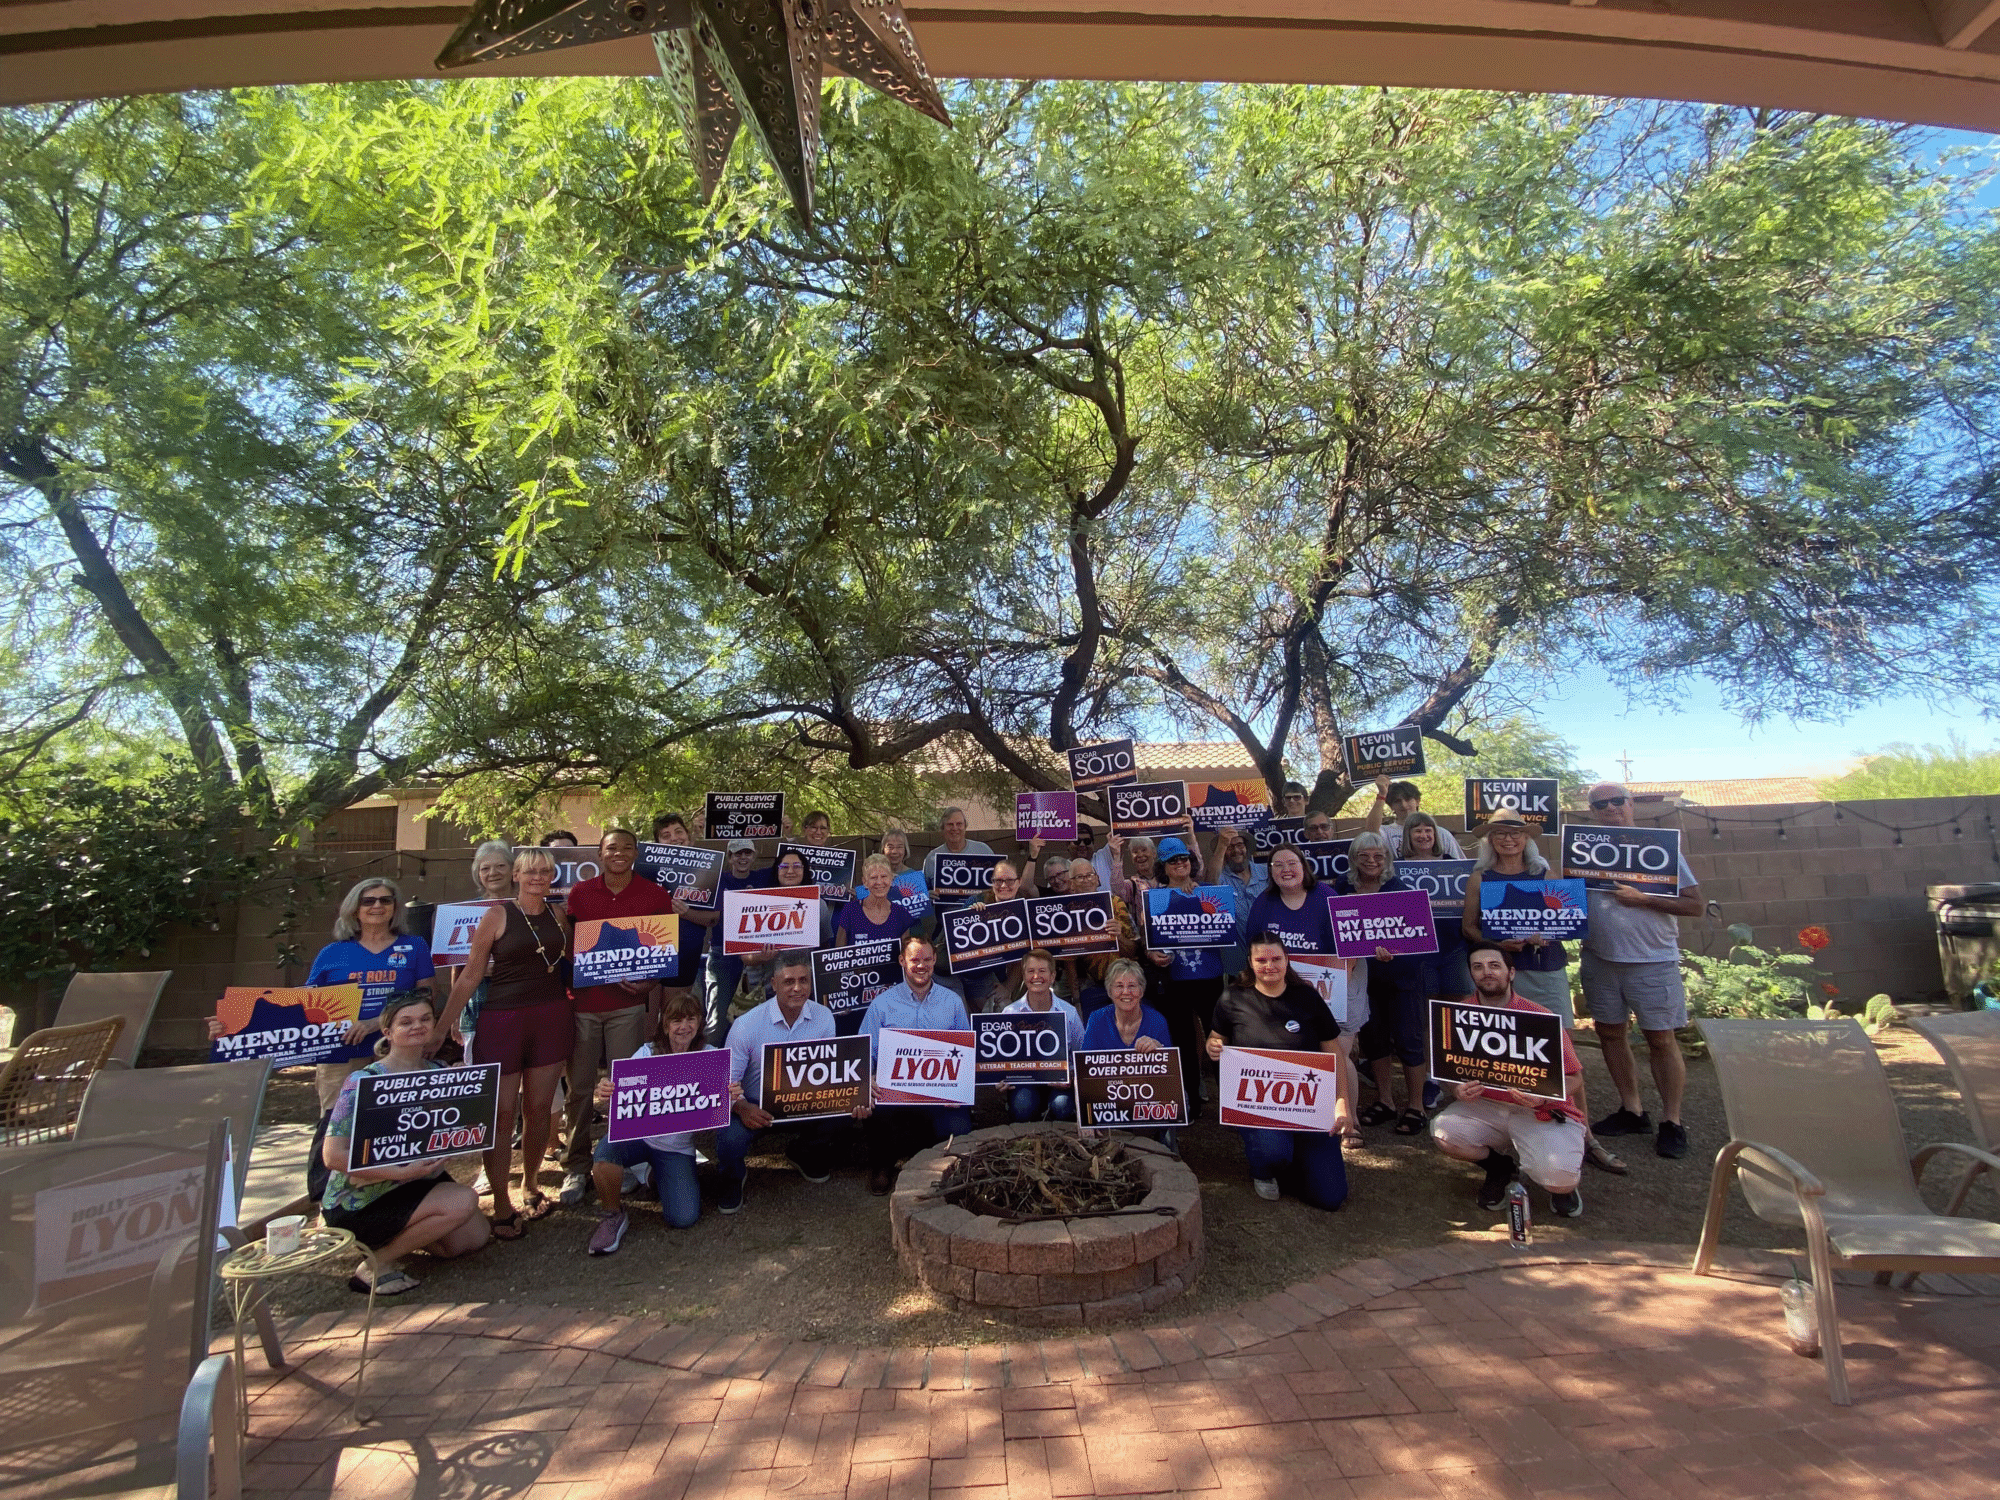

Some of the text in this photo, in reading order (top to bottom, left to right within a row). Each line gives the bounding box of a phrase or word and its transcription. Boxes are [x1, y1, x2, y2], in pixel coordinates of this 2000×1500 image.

[1359, 733, 1396, 746] KEVIN
[1075, 751, 1097, 760] EDGAR
[1361, 741, 1416, 761] VOLK
[1075, 752, 1130, 777] SOTO
[1357, 758, 1416, 771] PUBLIC SERVICE
[1483, 782, 1527, 792] KEVIN
[1117, 791, 1143, 799] EDGAR
[1116, 795, 1181, 819] SOTO
[1192, 804, 1267, 816] MENDOZA
[1483, 794, 1549, 812] VOLK
[728, 814, 762, 824] SOTO
[1018, 810, 1058, 820] MY BODY.
[1018, 818, 1072, 828] MY BALLOT.
[744, 826, 777, 836] LYON
[1574, 833, 1611, 842] EDGAR
[645, 846, 716, 861] PUBLIC SERVICE
[820, 850, 848, 859] SERVICE
[1571, 841, 1670, 870] SOTO
[646, 855, 712, 869] OVER POLITICS
[810, 857, 845, 866] POLITICS
[656, 871, 696, 885] SOTO
[940, 866, 994, 886] SOTO
[1569, 869, 1600, 877] VETERAN
[673, 887, 712, 903] LYON
[742, 905, 769, 913] HOLLY
[1036, 904, 1063, 913] EDGAR
[1481, 908, 1587, 920] MENDOZA
[738, 910, 806, 934] LYON
[953, 915, 980, 927] EDGAR
[1035, 908, 1107, 936] SOTO
[1151, 913, 1235, 925] MENDOZA
[1337, 916, 1406, 931] MY BODY.
[953, 916, 1023, 949] SOTO
[1280, 932, 1305, 942] BODY.
[1339, 926, 1428, 942] MY BALLOT.
[574, 944, 678, 966] MENDOZA
[822, 944, 892, 962] PUBLIC SERVICE
[955, 951, 979, 959] VETERAN
[983, 946, 1005, 954] TEACHER
[610, 957, 672, 968] CONGRESS
[825, 954, 891, 972] OVER POLITICS
[366, 970, 396, 982] BOLD
[840, 971, 880, 990] SOTO
[367, 987, 395, 996] STRONG
[828, 991, 849, 1000] KEVIN
[829, 996, 859, 1010] VOLK
[982, 1022, 1012, 1031] EDGAR
[1455, 1009, 1516, 1031] KEVIN
[217, 1020, 353, 1052] MENDOZA
[979, 1030, 1060, 1058] SOTO
[1456, 1027, 1550, 1063] VOLK
[225, 1048, 256, 1058] FOR
[786, 1044, 837, 1062] KEVIN
[1085, 1053, 1168, 1064] PUBLIC SERVICE
[786, 1059, 862, 1088] VOLK
[891, 1057, 961, 1081] LYON
[1089, 1065, 1167, 1076] OVER POLITICS
[1240, 1068, 1273, 1078] HOLLY
[1446, 1054, 1548, 1078] PUBLIC SERVICE
[373, 1069, 487, 1092] PUBLIC SERVICE
[1456, 1066, 1484, 1078] OVER
[1488, 1071, 1537, 1087] POLITICS
[376, 1083, 482, 1105] OVER POLITICS
[617, 1082, 700, 1104] MY BODY.
[774, 1087, 859, 1103] PUBLIC SERVICE
[1107, 1084, 1154, 1100] SOTO
[1237, 1078, 1318, 1106] LYON
[617, 1094, 721, 1119] MY BALLOT.
[783, 1099, 850, 1113] OVER POLITICS
[1133, 1103, 1178, 1120] LYON
[397, 1107, 460, 1131] SOTO
[1094, 1110, 1130, 1122] VOLK
[373, 1134, 407, 1145] KEVIN
[427, 1125, 487, 1152] LYON
[373, 1141, 422, 1160] VOLK
[71, 1198, 124, 1224] HOLLY
[65, 1186, 204, 1263] LYON
